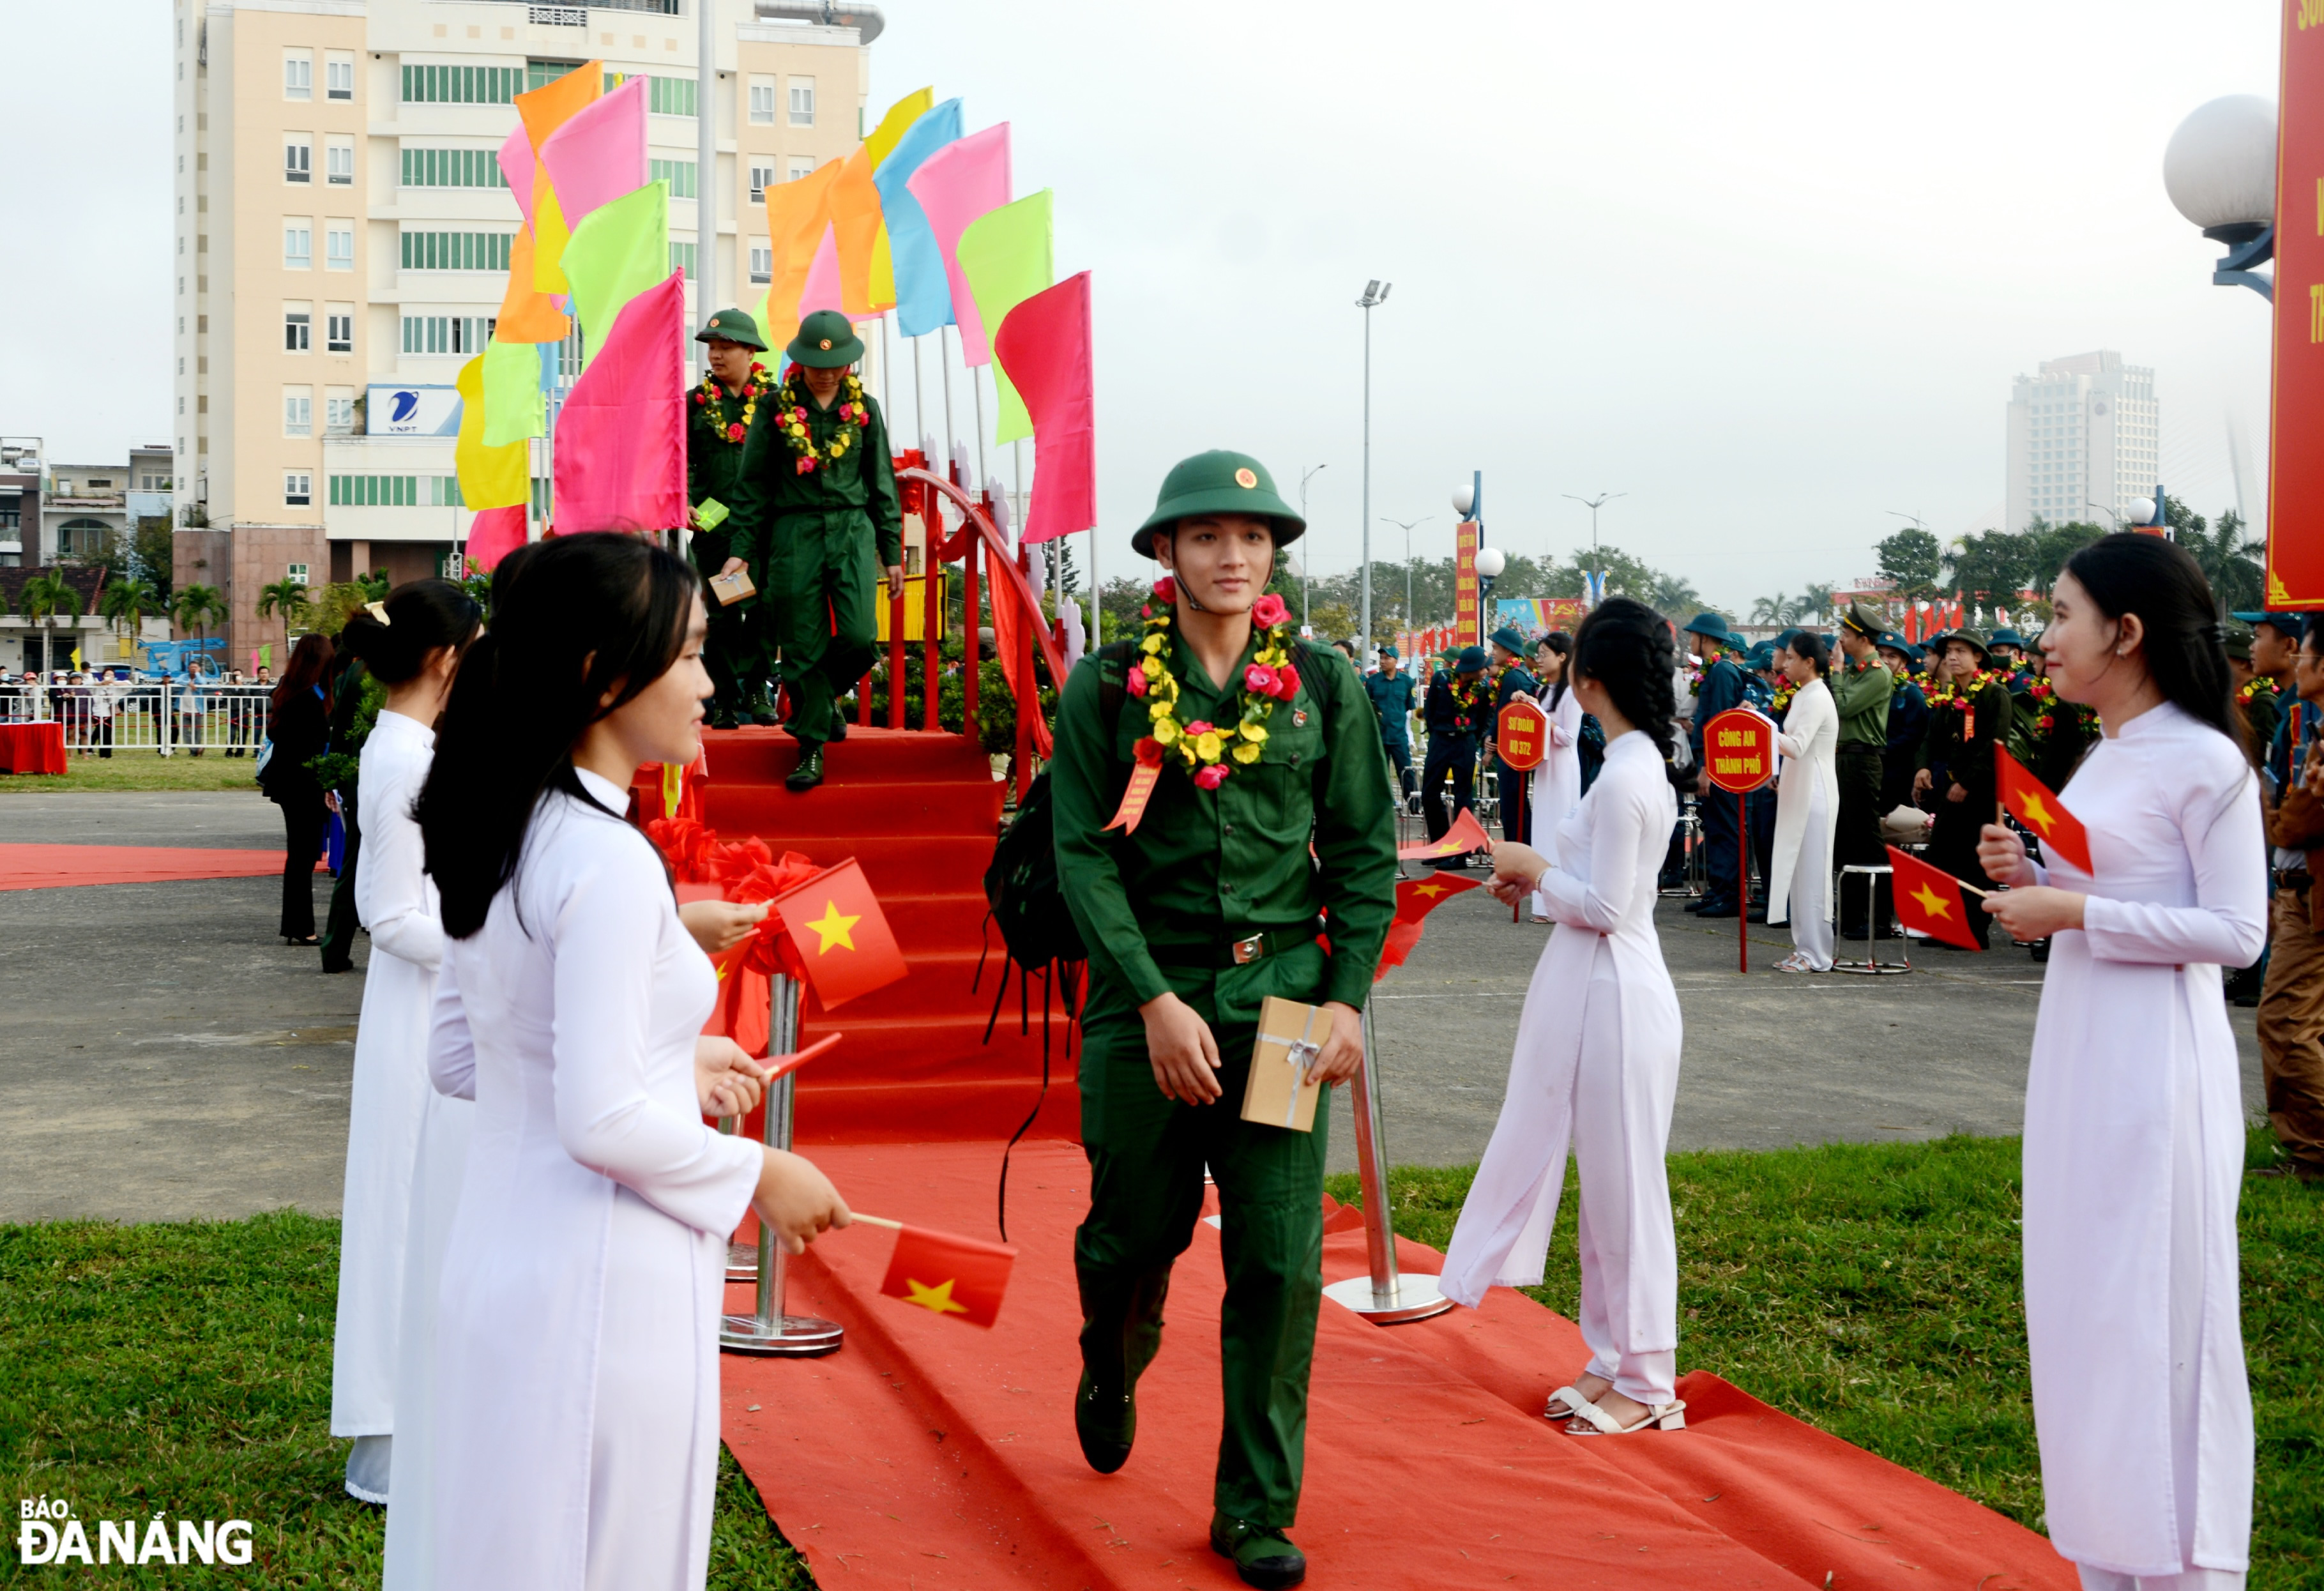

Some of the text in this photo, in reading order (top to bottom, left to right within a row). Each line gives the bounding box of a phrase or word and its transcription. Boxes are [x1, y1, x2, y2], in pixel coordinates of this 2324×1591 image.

[1508, 716, 1535, 733] SƯ ĐOÀN
[1718, 727, 1756, 747] CÔNG AN
[1519, 741, 1531, 756] 372
[1715, 752, 1761, 774] THÀNH PHỐ
